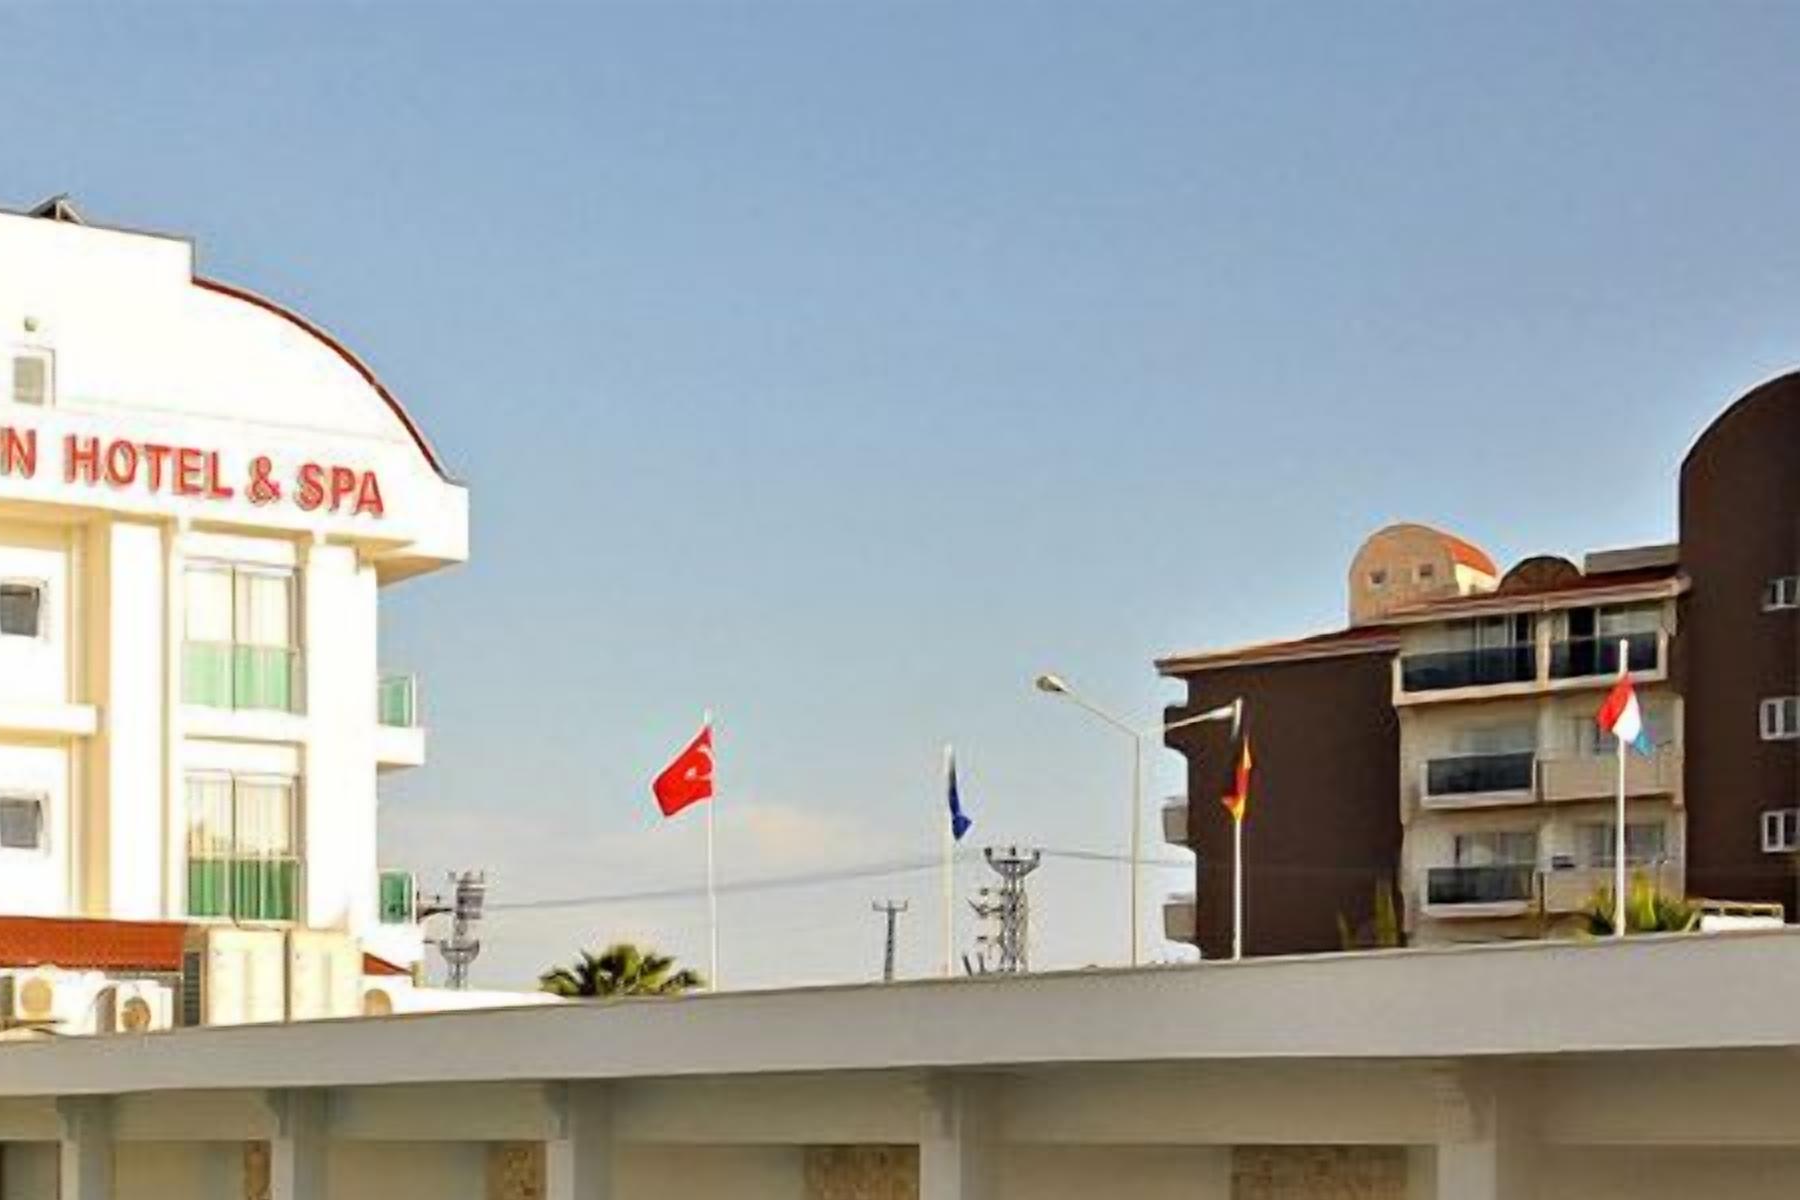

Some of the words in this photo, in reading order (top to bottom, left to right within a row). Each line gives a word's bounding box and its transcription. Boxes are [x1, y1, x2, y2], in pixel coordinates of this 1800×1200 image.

[64, 434, 234, 499] HOTEL
[246, 456, 283, 506] &
[294, 463, 384, 517] SPA
